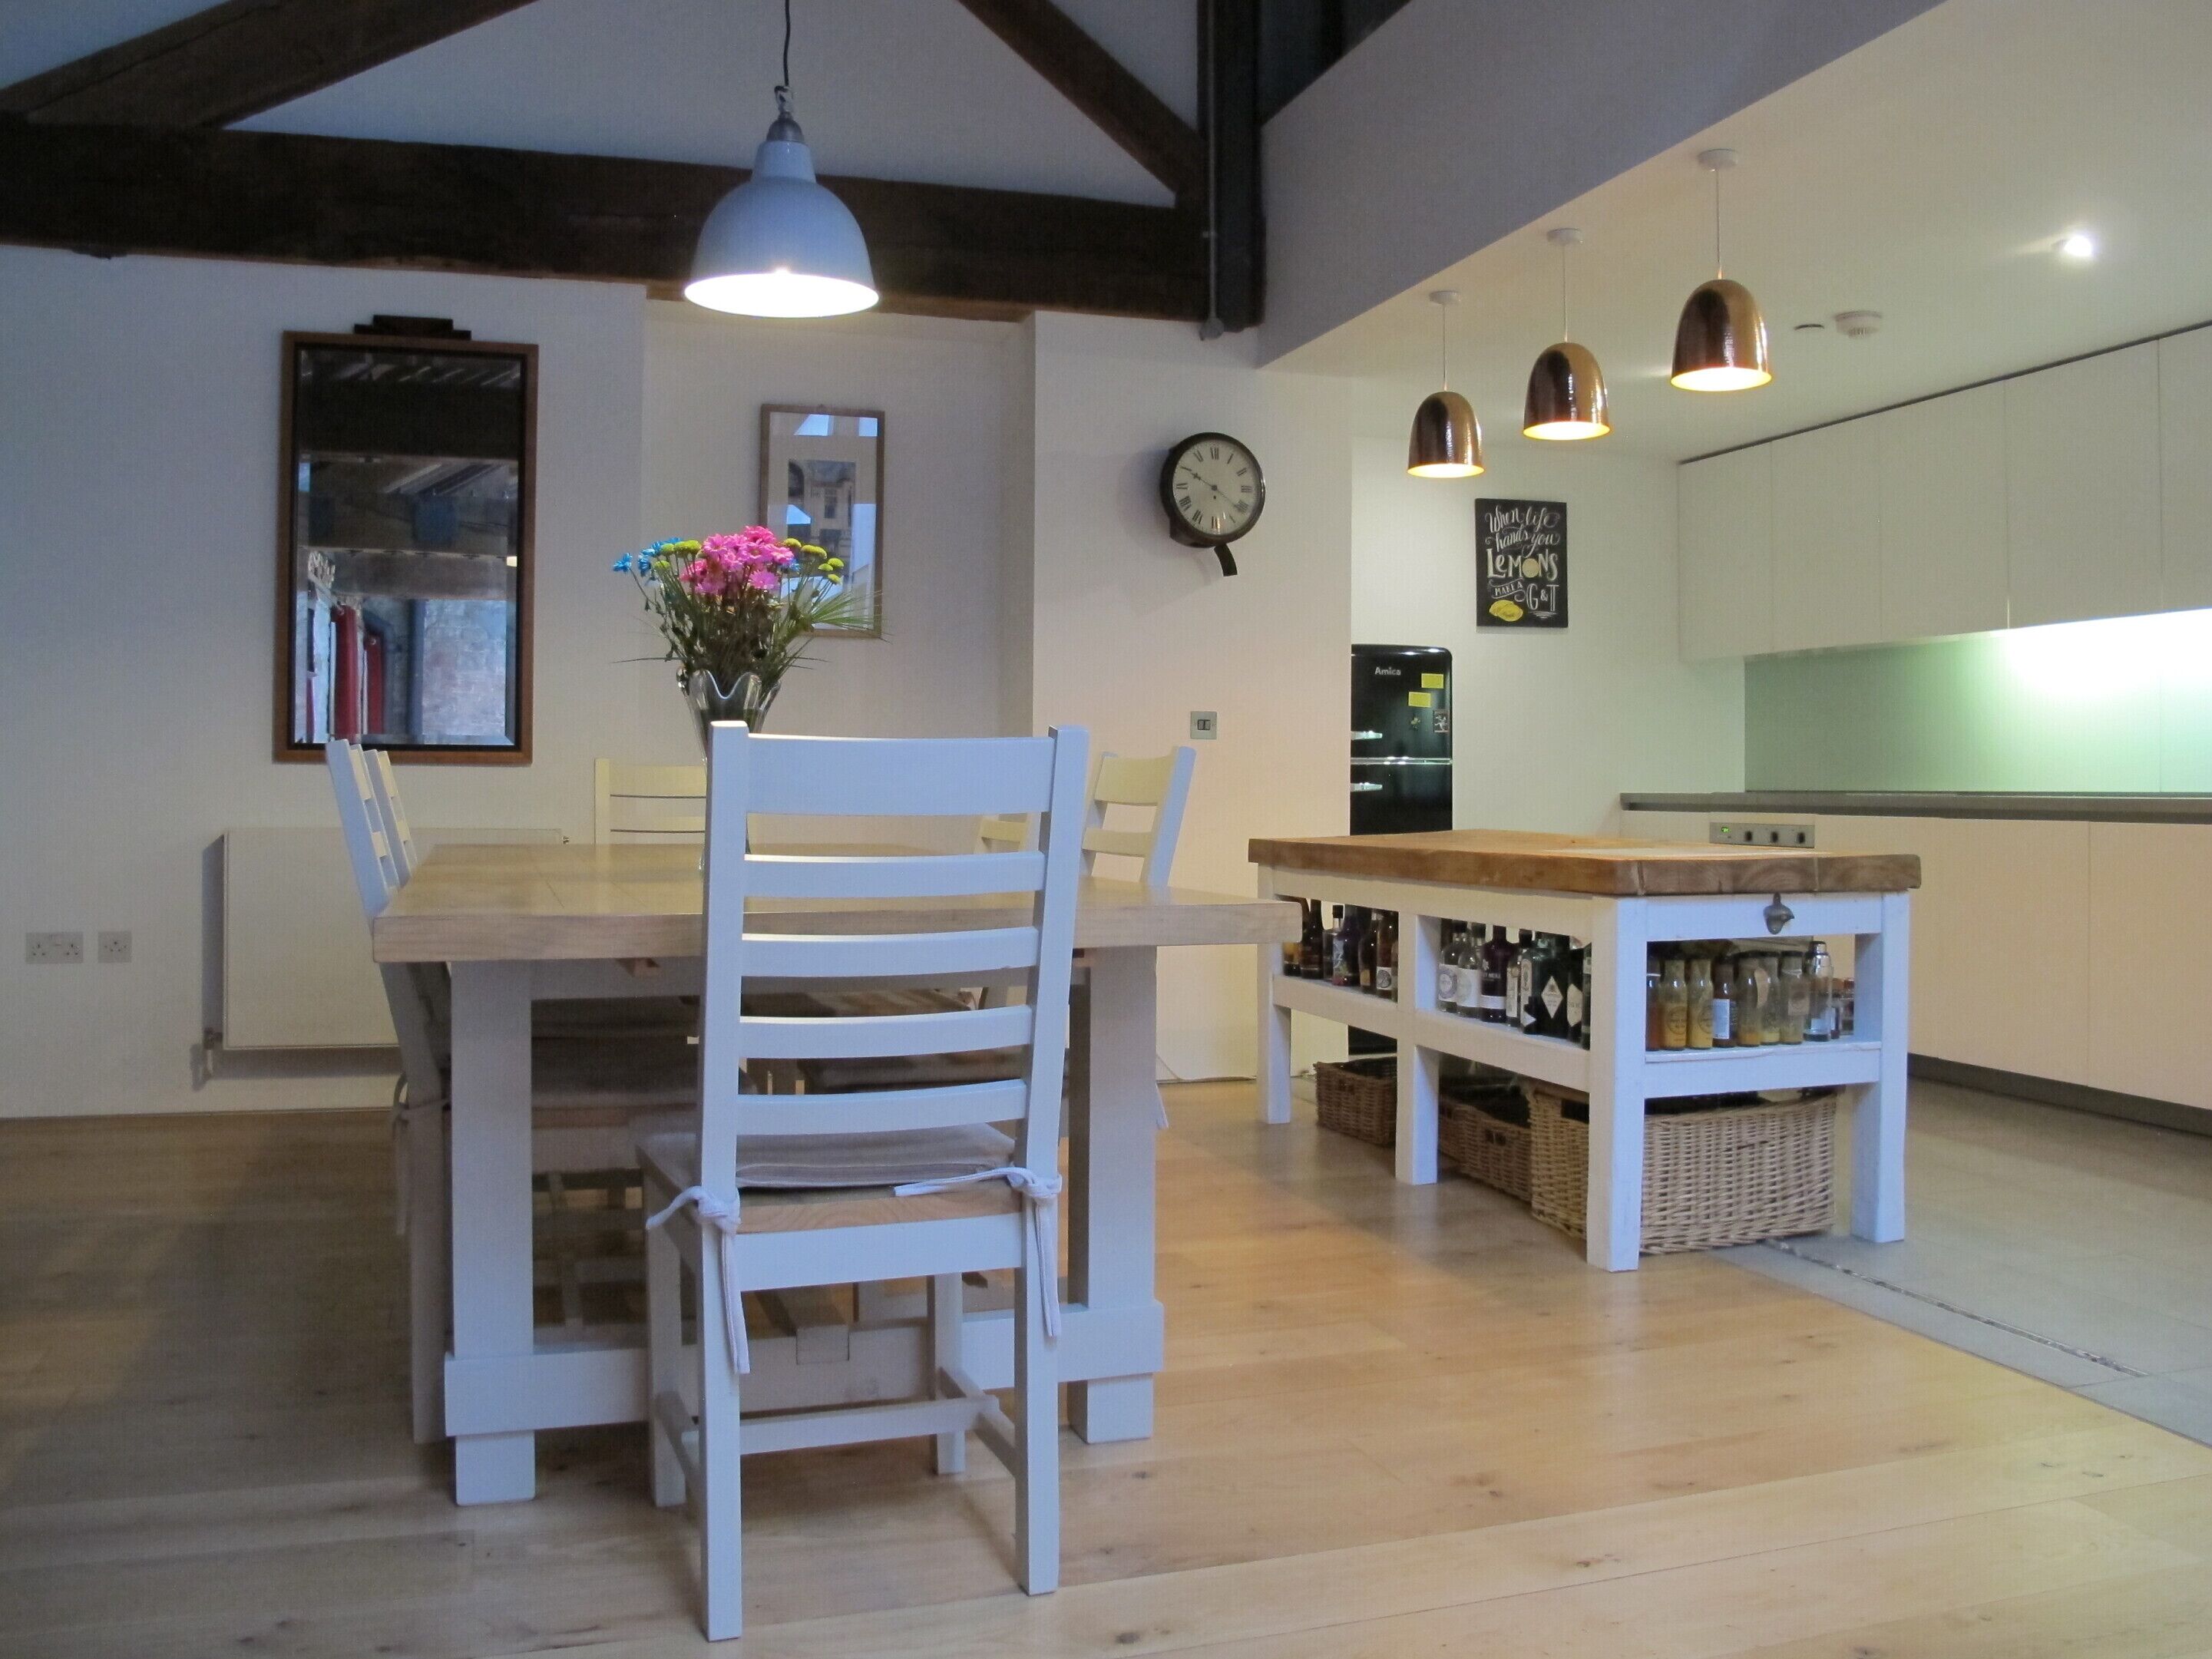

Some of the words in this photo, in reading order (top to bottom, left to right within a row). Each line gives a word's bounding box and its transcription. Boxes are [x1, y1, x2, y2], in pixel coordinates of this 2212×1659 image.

[1485, 504, 1524, 533] When
[1526, 506, 1559, 532] life
[1486, 524, 1529, 552] hands
[1522, 532, 1560, 558] you
[1374, 666, 1401, 676] Amica
